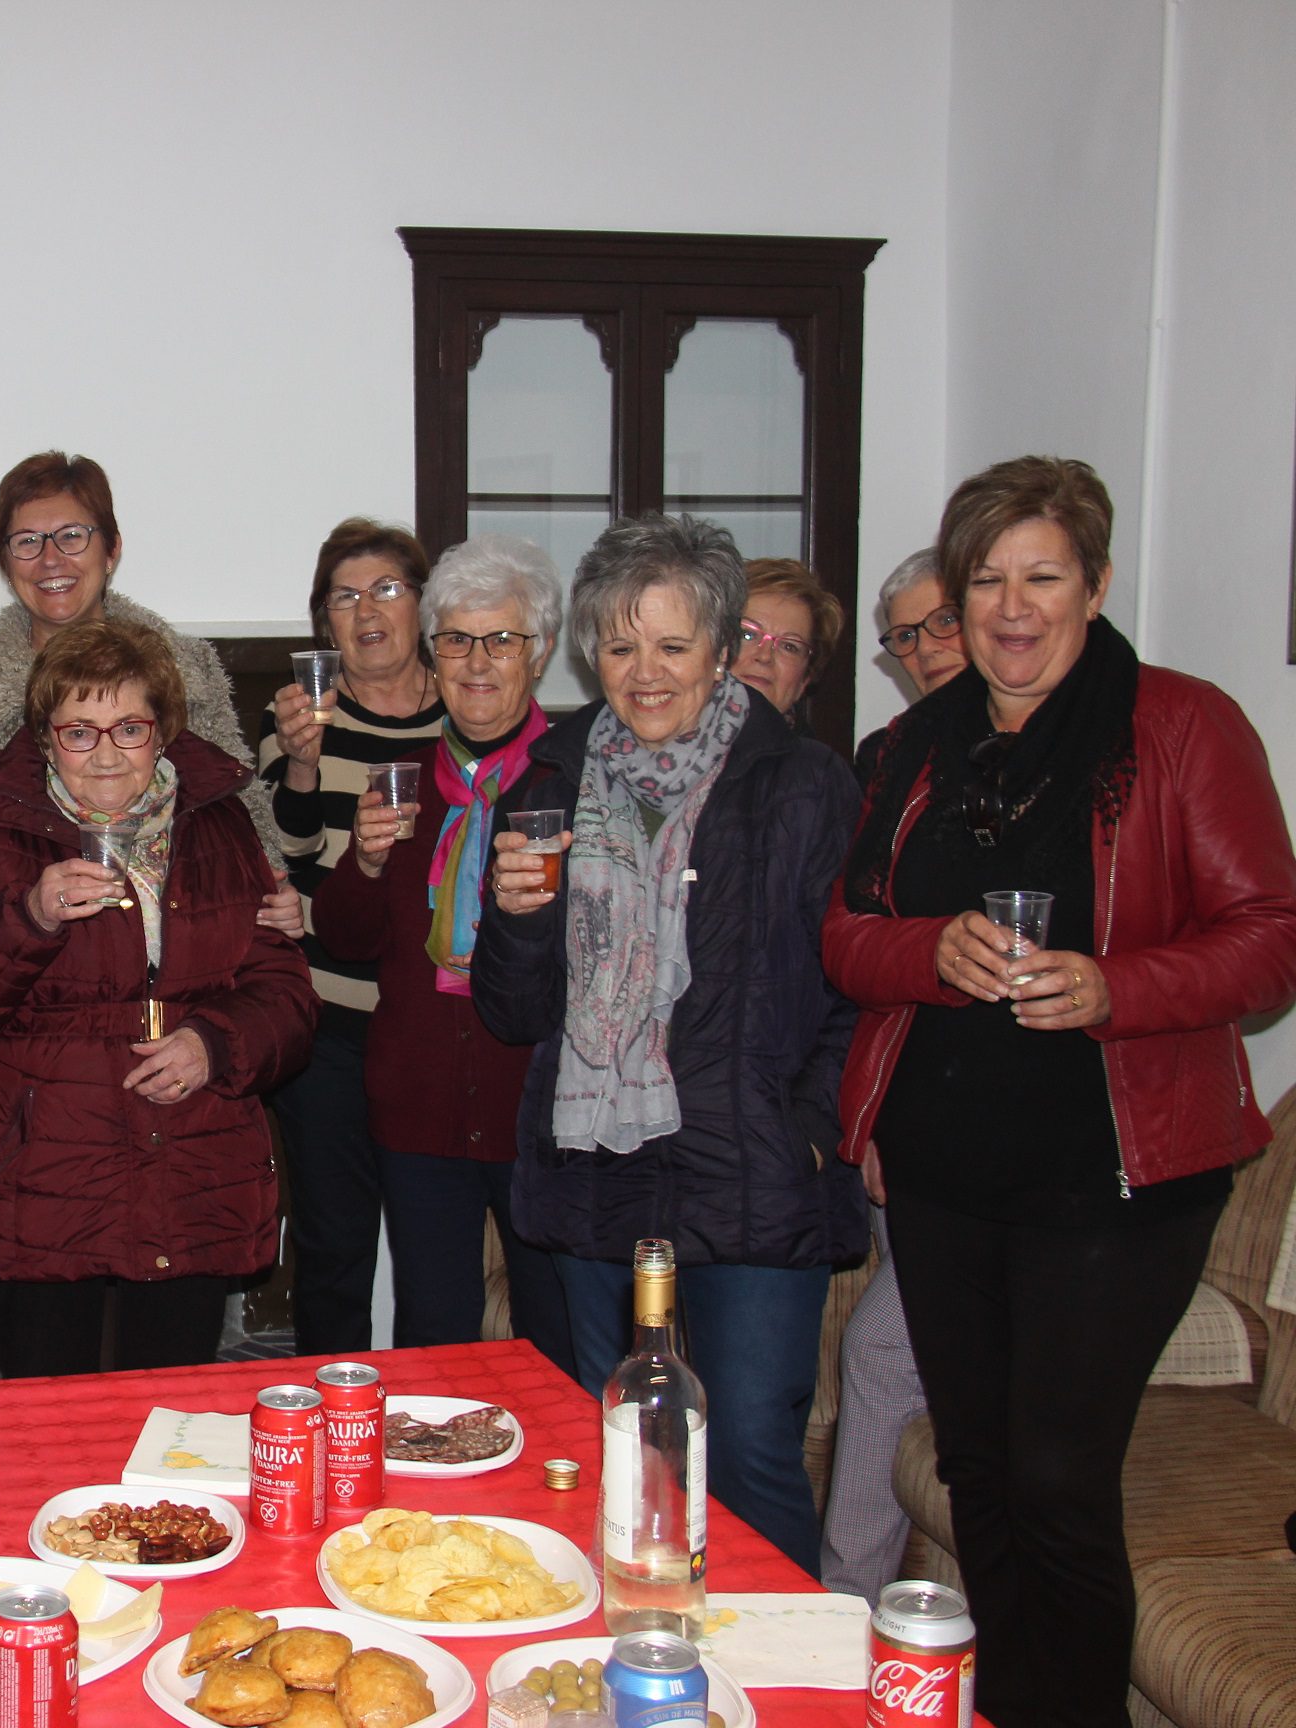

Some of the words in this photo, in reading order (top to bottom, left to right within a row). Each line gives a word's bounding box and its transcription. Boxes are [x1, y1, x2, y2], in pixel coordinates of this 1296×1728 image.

[328, 1420, 376, 1439] AURA
[331, 1439, 359, 1447] DAMM
[328, 1453, 371, 1463] UTEN-FREE
[257, 1460, 283, 1472] DAMM
[882, 1617, 907, 1633] LIGHT
